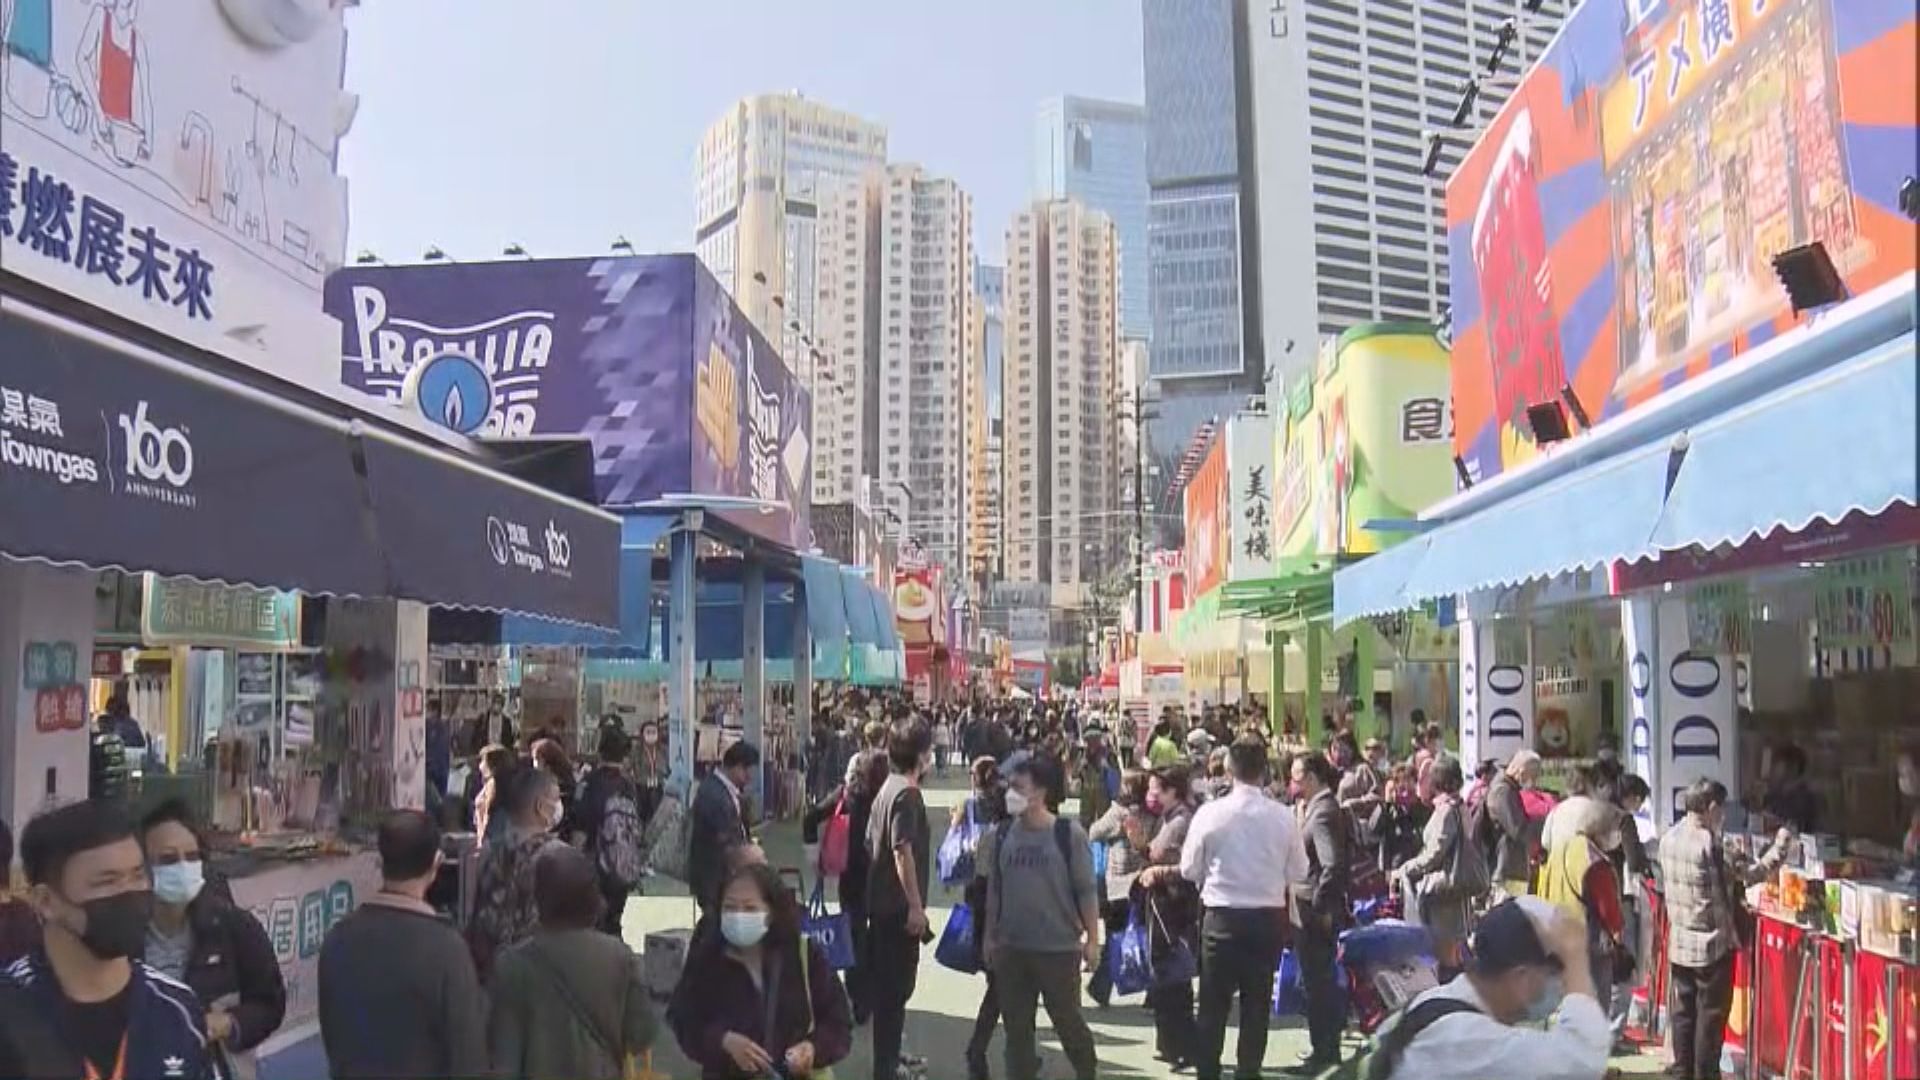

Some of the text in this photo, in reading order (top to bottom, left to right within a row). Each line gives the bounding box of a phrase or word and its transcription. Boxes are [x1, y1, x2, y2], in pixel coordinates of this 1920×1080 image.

[1403, 397, 1455, 441] 食
[0, 428, 98, 484] Towngas
[1243, 464, 1271, 562] 美味棧
